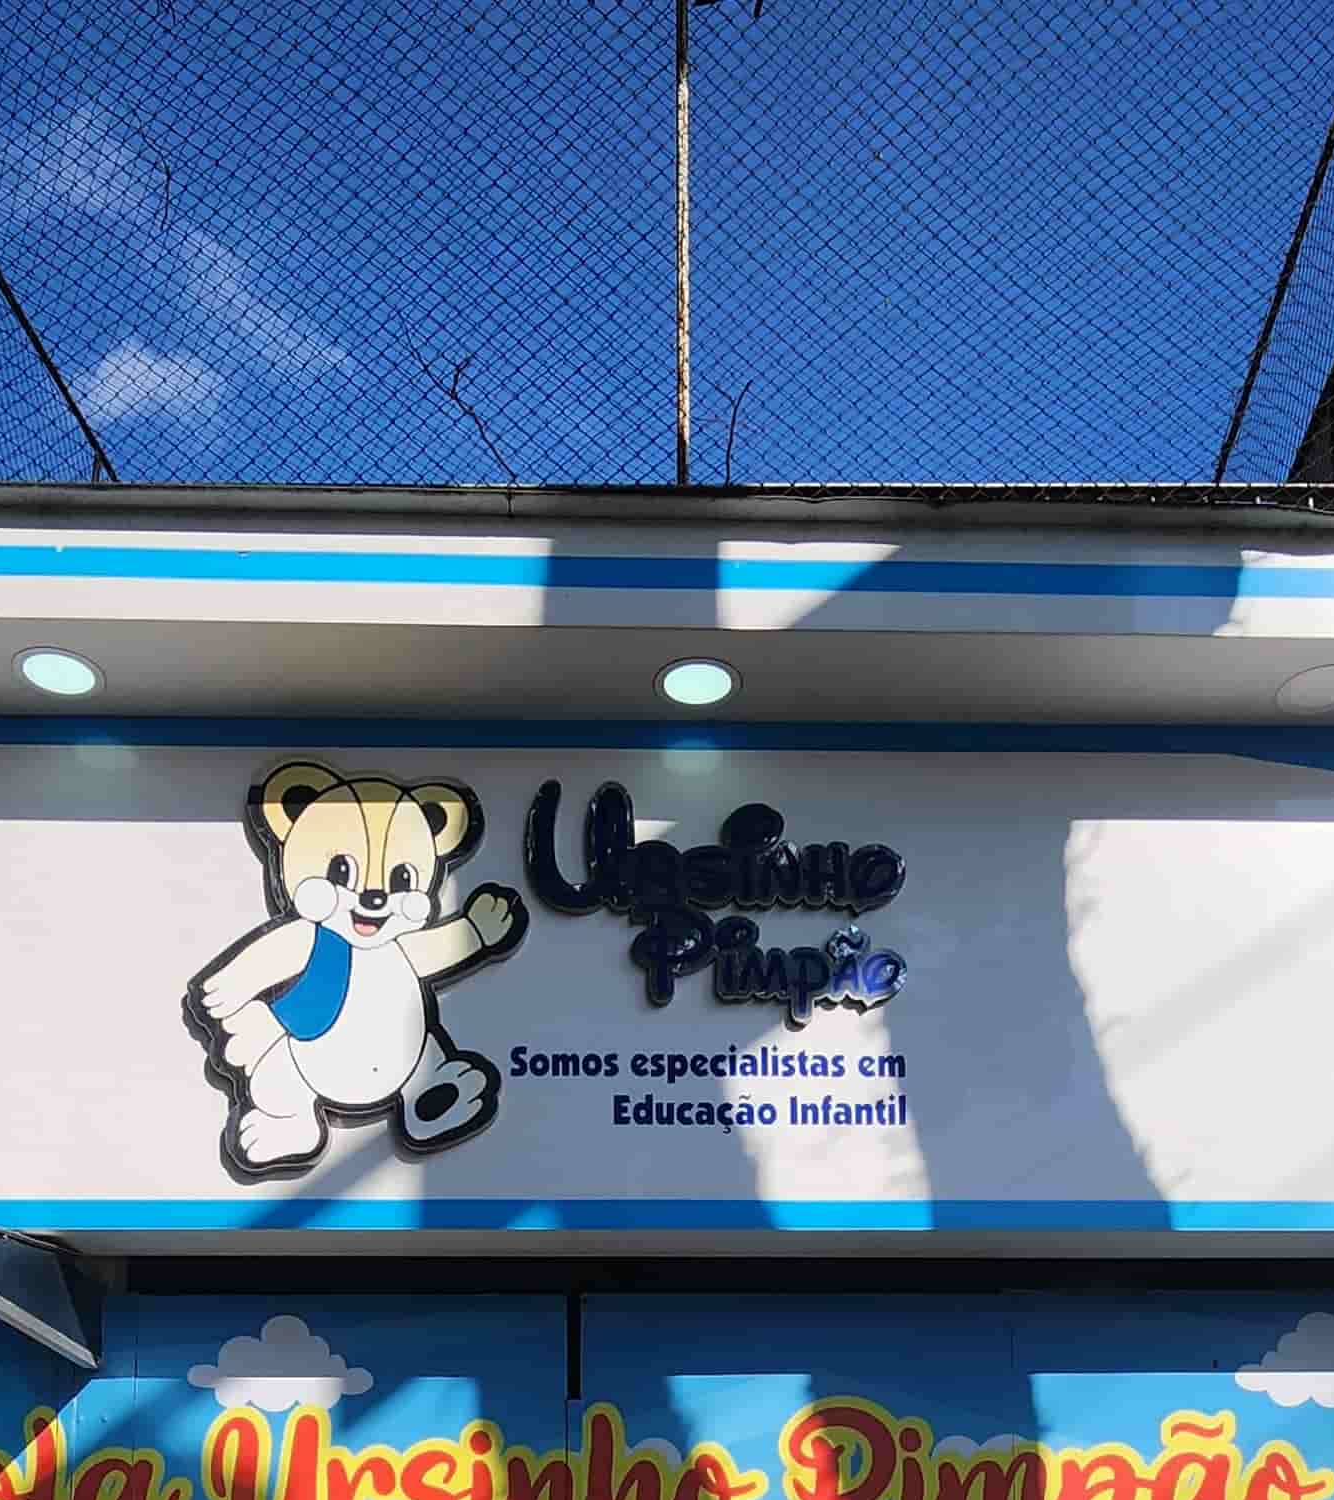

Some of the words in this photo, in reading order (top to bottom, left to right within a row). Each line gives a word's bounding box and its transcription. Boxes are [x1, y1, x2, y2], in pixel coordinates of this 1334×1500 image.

[509, 1045, 619, 1077] Somos
[629, 1044, 846, 1084] especialistas
[857, 1052, 907, 1077] em
[612, 1093, 778, 1134] Educação
[788, 1094, 907, 1126] Infantil
